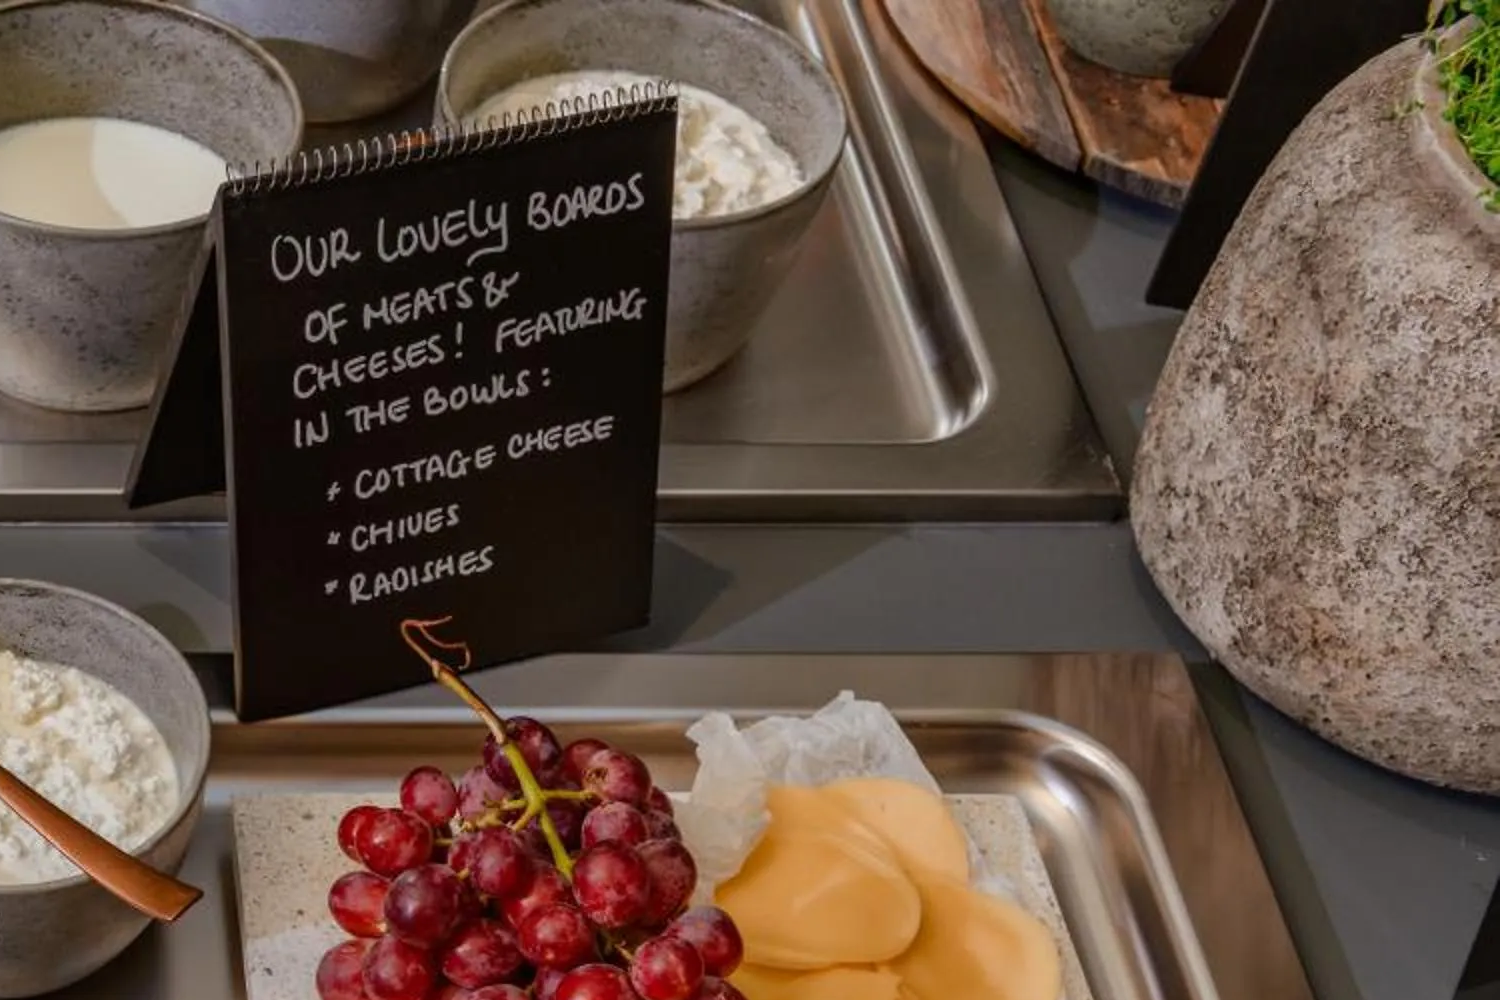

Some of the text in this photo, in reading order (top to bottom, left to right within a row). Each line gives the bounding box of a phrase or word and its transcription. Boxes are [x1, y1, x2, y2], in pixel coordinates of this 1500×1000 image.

[271, 173, 645, 281] OUR LOVELY BOARDS
[304, 271, 520, 344] OF MEATS &
[496, 288, 647, 352] FEATURING
[295, 411, 329, 448] IN
[346, 397, 410, 433] THE
[355, 416, 615, 499] COTTAGE CHEESE
[351, 504, 461, 551] CHIVES
[350, 546, 495, 604] RADISHES
